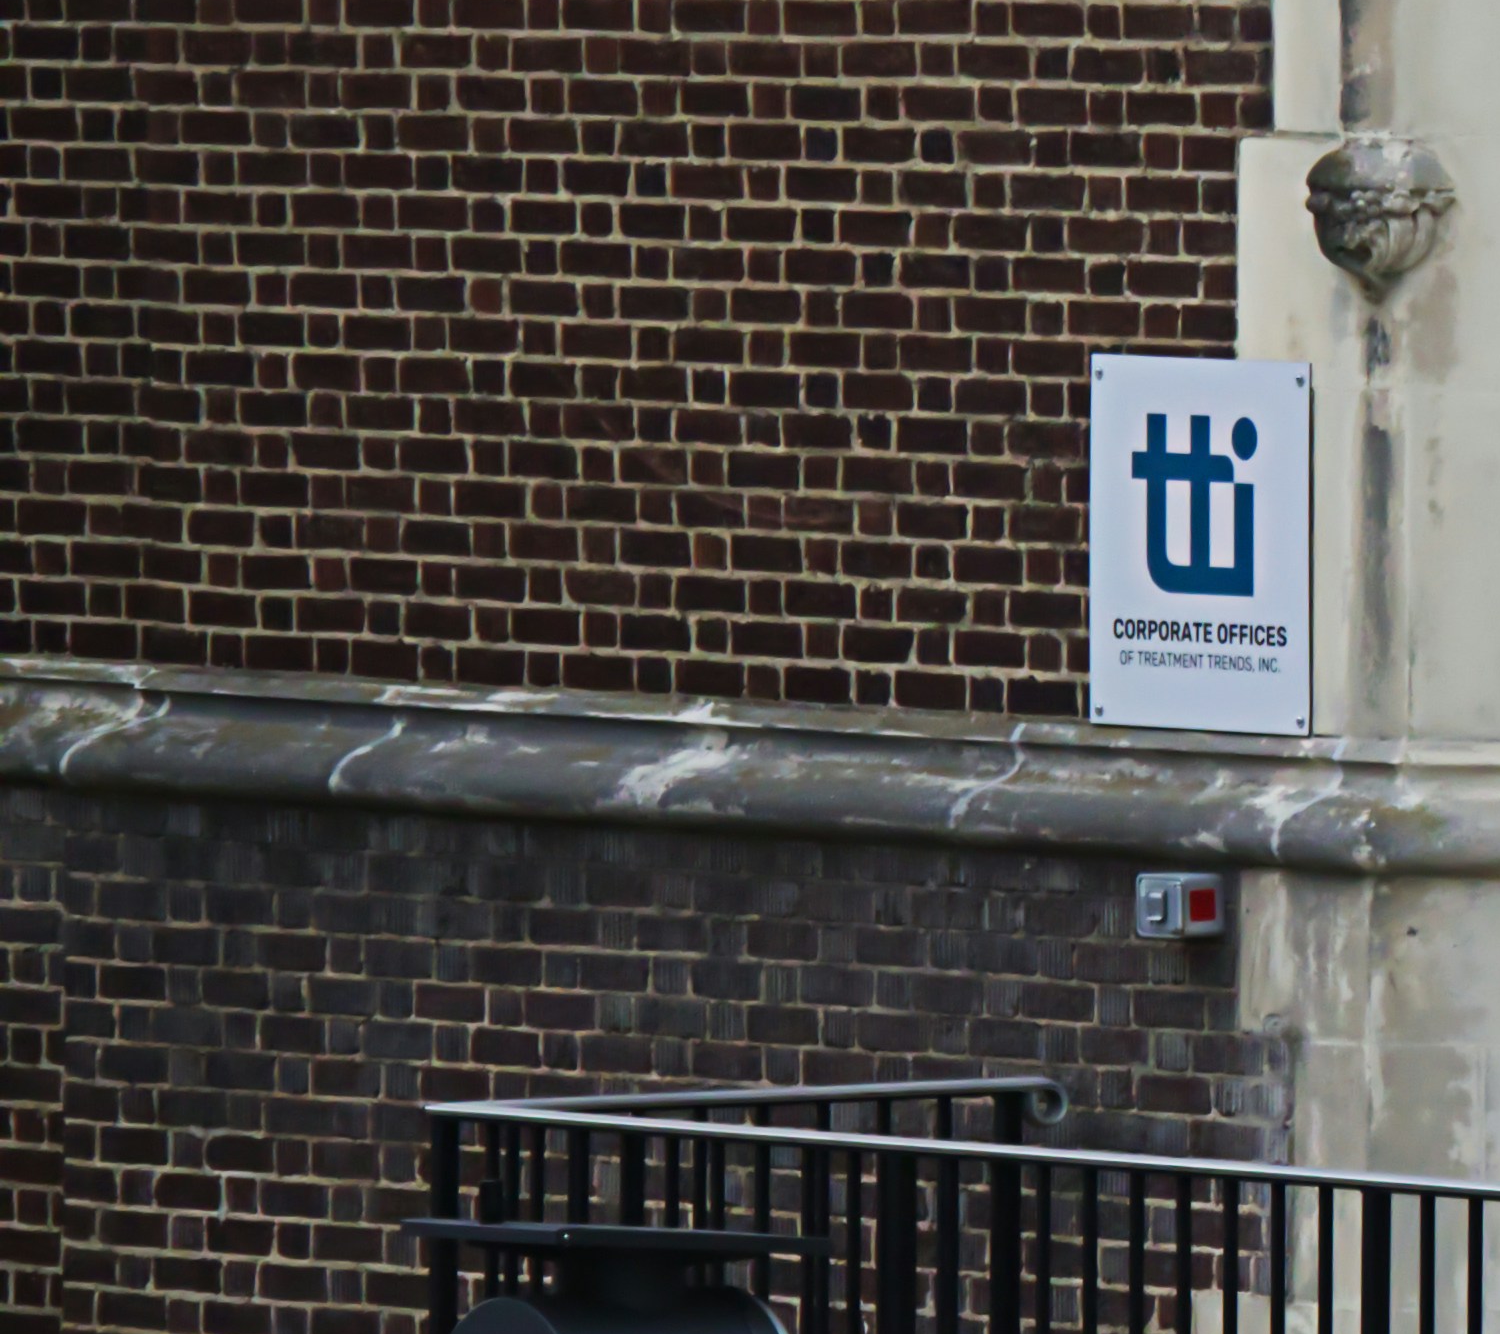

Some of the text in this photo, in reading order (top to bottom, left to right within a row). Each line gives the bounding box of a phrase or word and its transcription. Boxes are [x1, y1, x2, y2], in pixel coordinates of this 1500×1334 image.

[1131, 412, 1258, 598] tti
[1113, 618, 1288, 647] CORPORATE OFFICES
[1119, 649, 1281, 674] OF TREATMENT TRENDS, INC.
